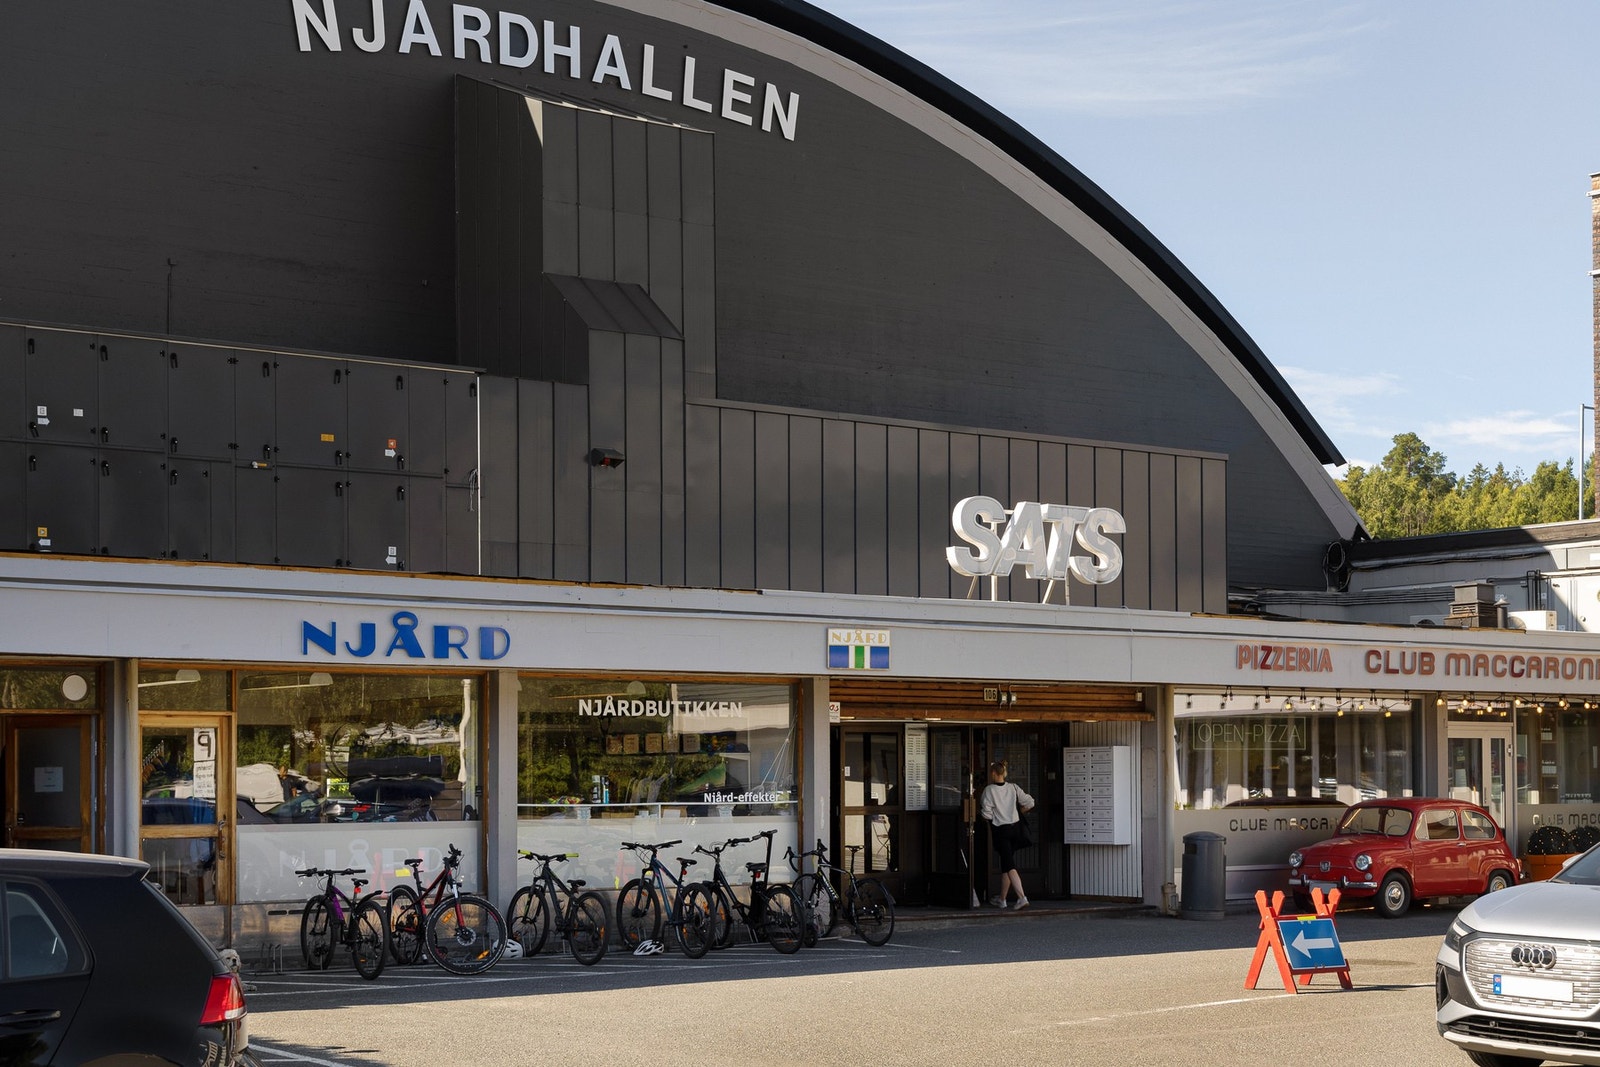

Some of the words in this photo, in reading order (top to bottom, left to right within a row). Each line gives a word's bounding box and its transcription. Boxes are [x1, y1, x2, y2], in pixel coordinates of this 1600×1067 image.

[946, 496, 1127, 585] SATS
[302, 611, 511, 660] NJÅRD
[831, 629, 887, 644] NJÅRD
[1235, 645, 1334, 673] PIZZERIA
[1364, 649, 1436, 676] CLUB
[578, 695, 743, 718] NJÅRDBUTIKKEN
[704, 791, 780, 804] Njård-effekter
